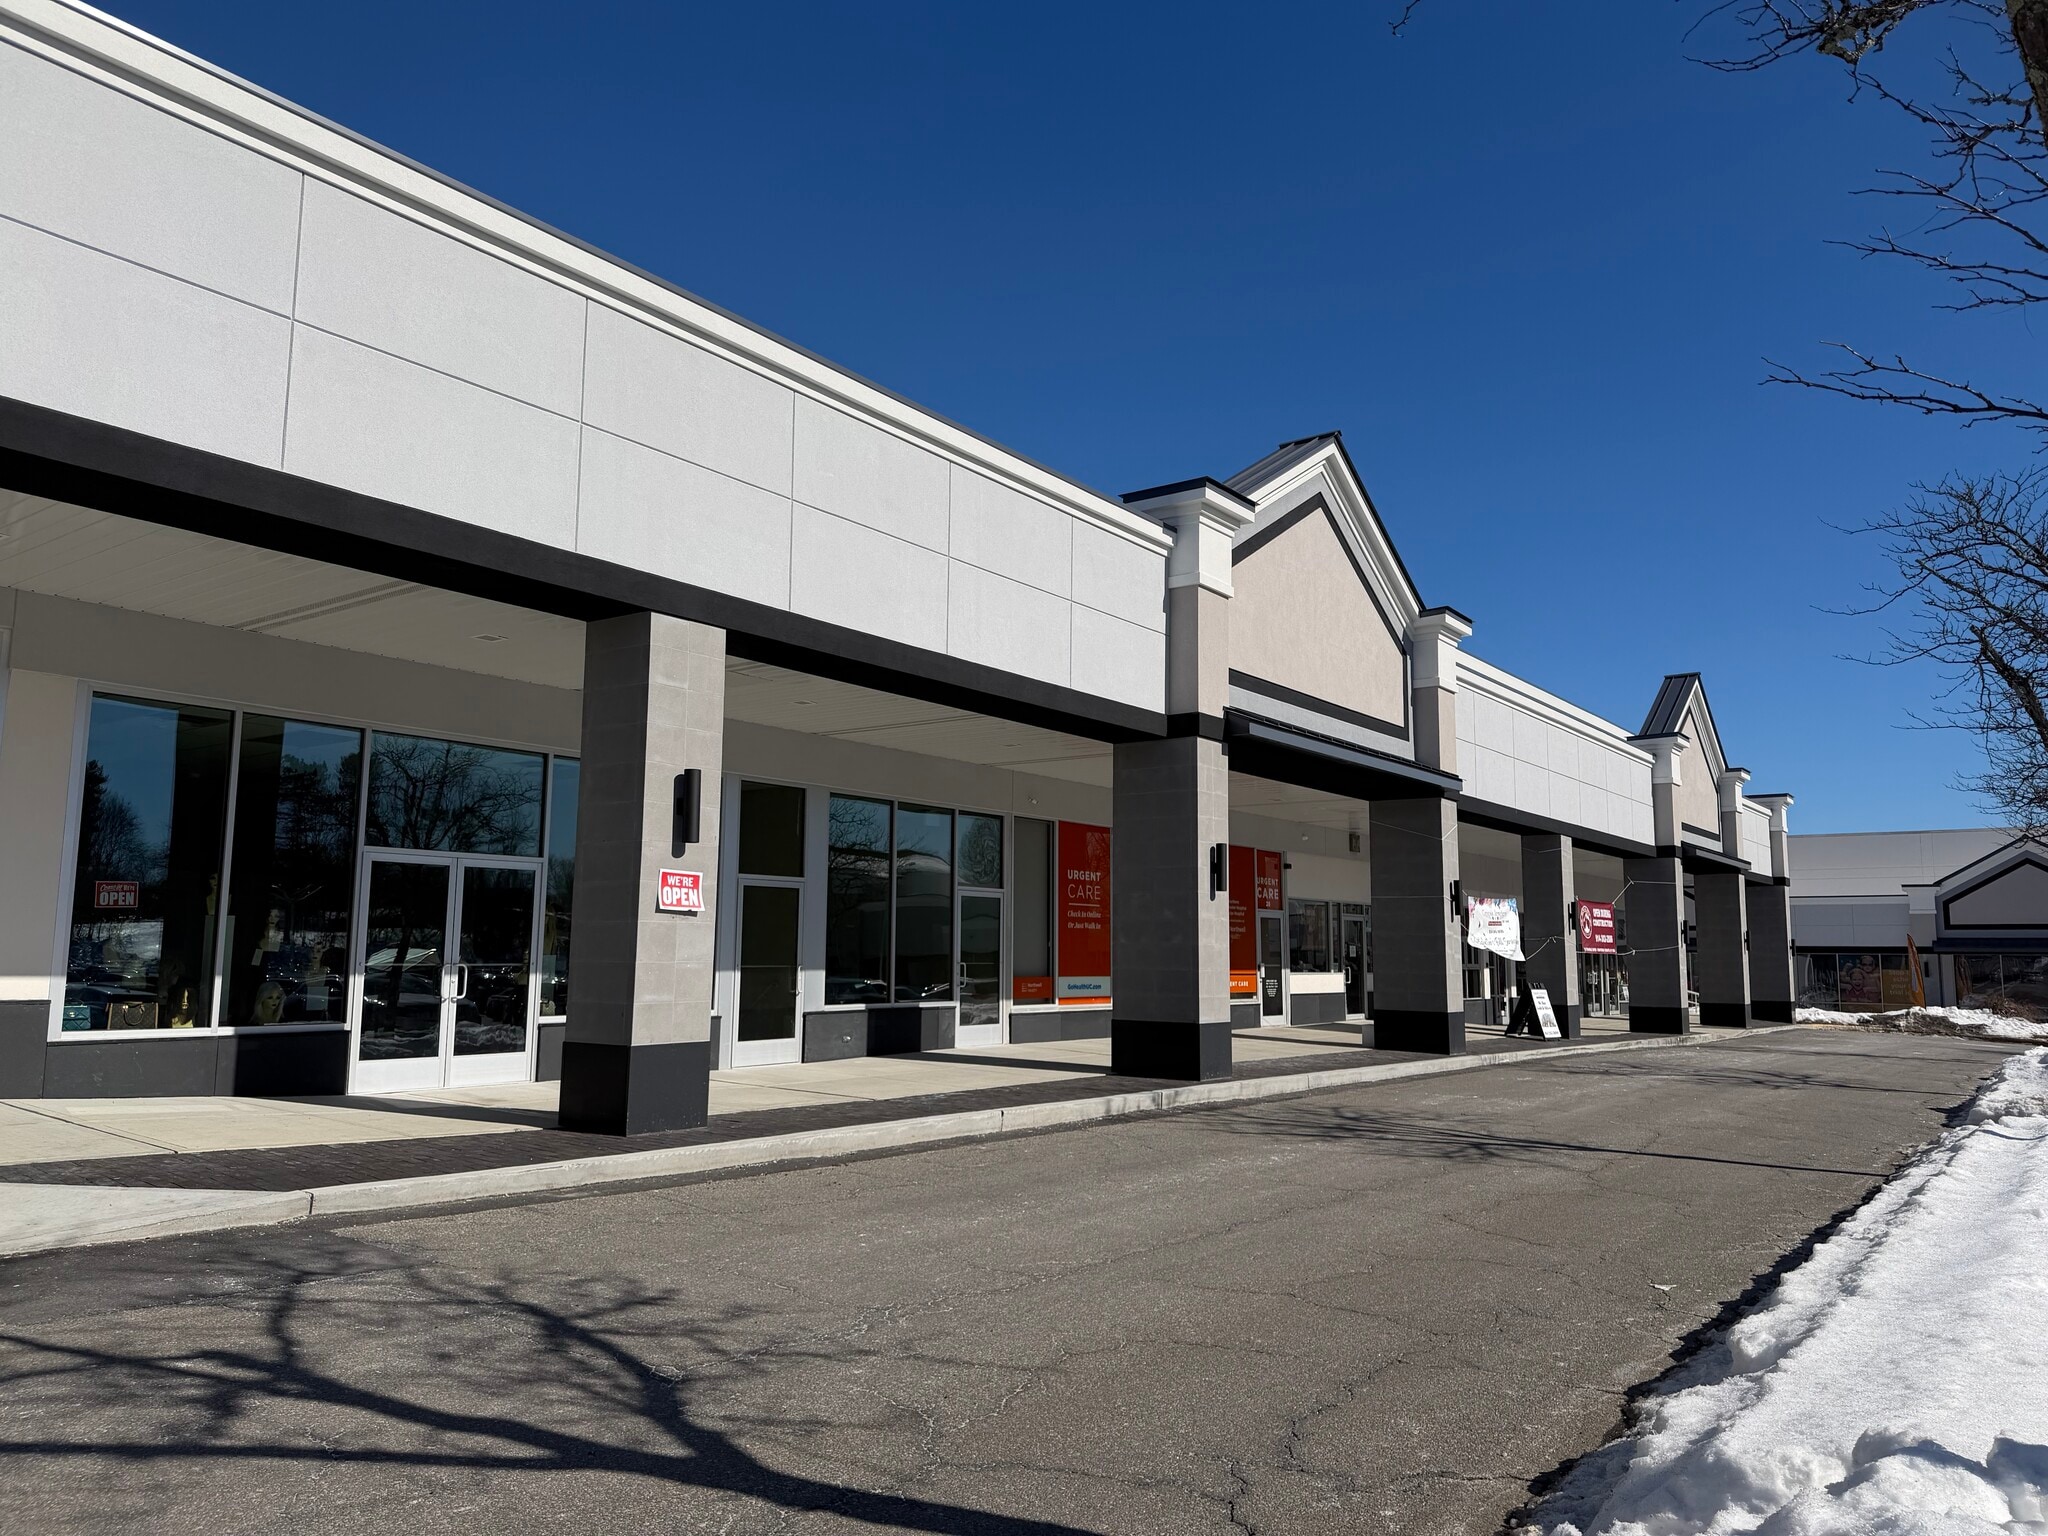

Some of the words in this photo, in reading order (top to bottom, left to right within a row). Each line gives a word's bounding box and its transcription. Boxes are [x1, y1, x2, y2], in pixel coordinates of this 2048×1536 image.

[667, 875, 694, 887] WE'RE
[1067, 869, 1101, 881] URGENT
[1256, 877, 1278, 886] URGENT
[99, 891, 135, 906] OPEN
[662, 885, 699, 906] OPEN
[1067, 883, 1101, 900] CARE
[1257, 886, 1279, 900] CARE
